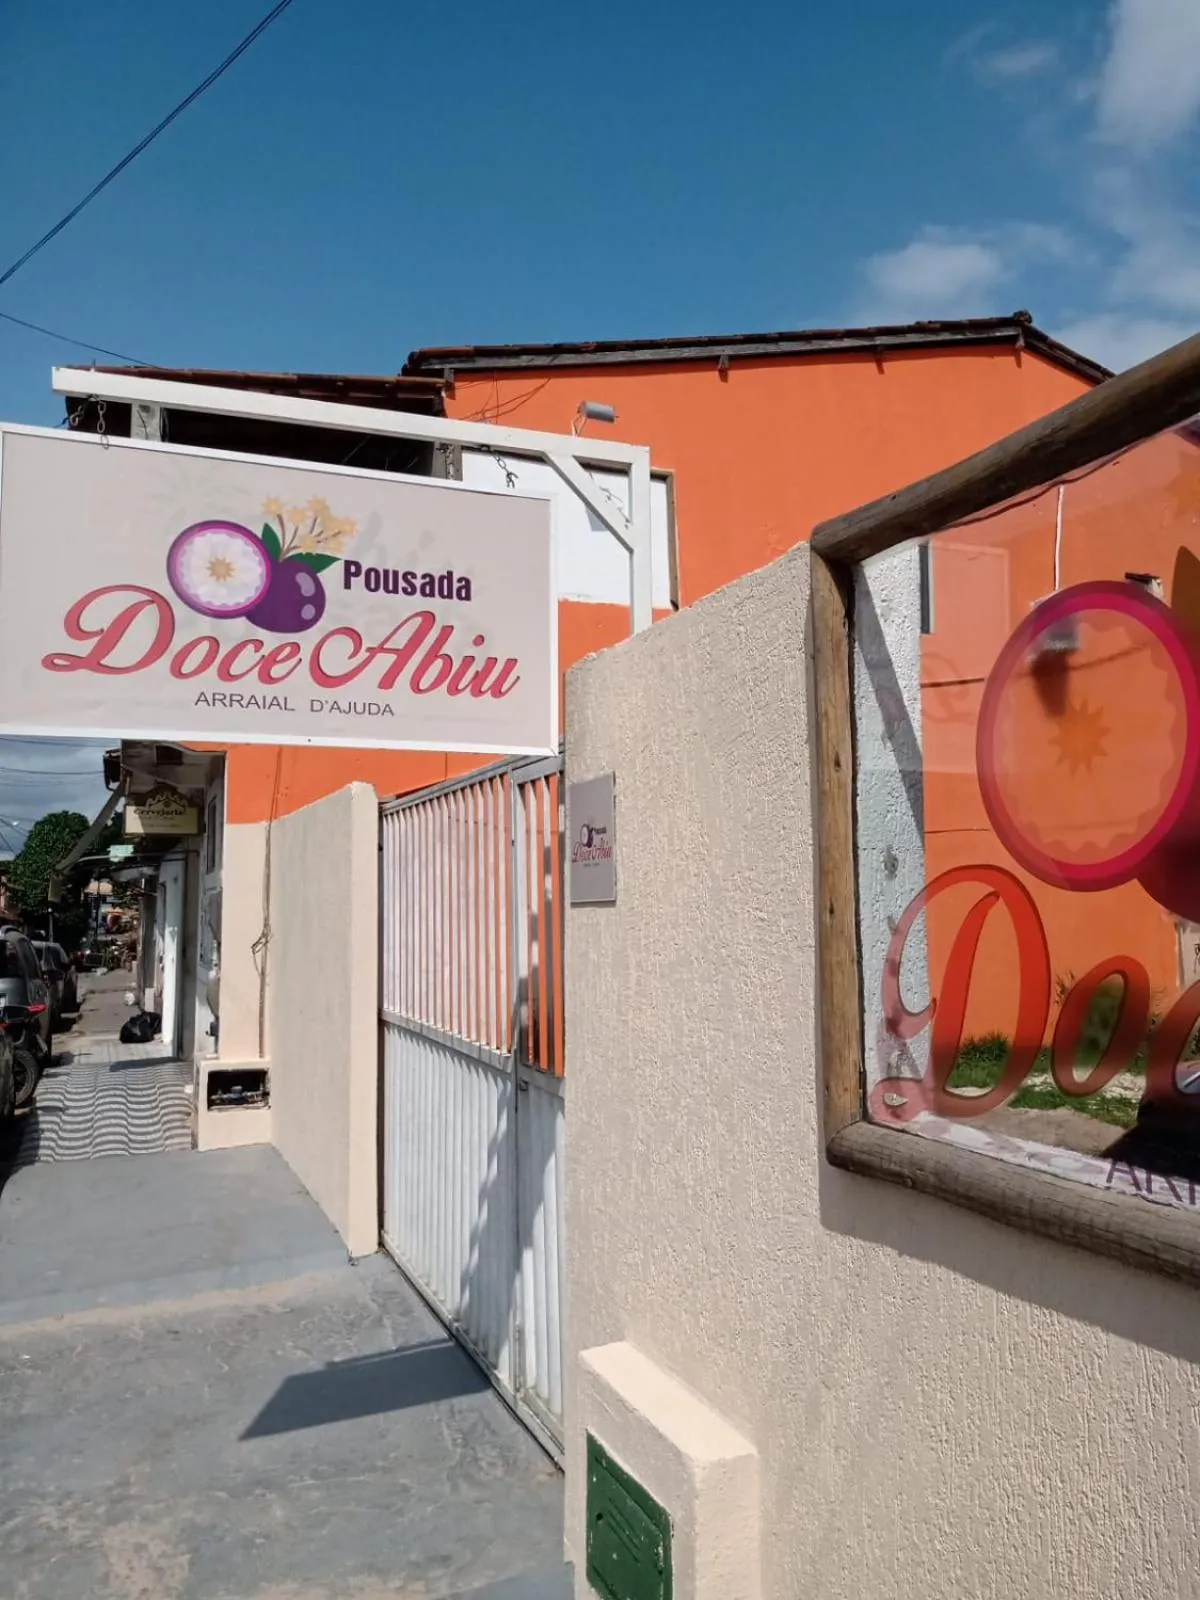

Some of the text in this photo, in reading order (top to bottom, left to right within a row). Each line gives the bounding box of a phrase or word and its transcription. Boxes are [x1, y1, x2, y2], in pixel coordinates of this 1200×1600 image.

[343, 559, 473, 602] Pousada
[41, 584, 521, 699] Doce Abiu
[194, 690, 395, 717] ARRAIAL D'AJUDA
